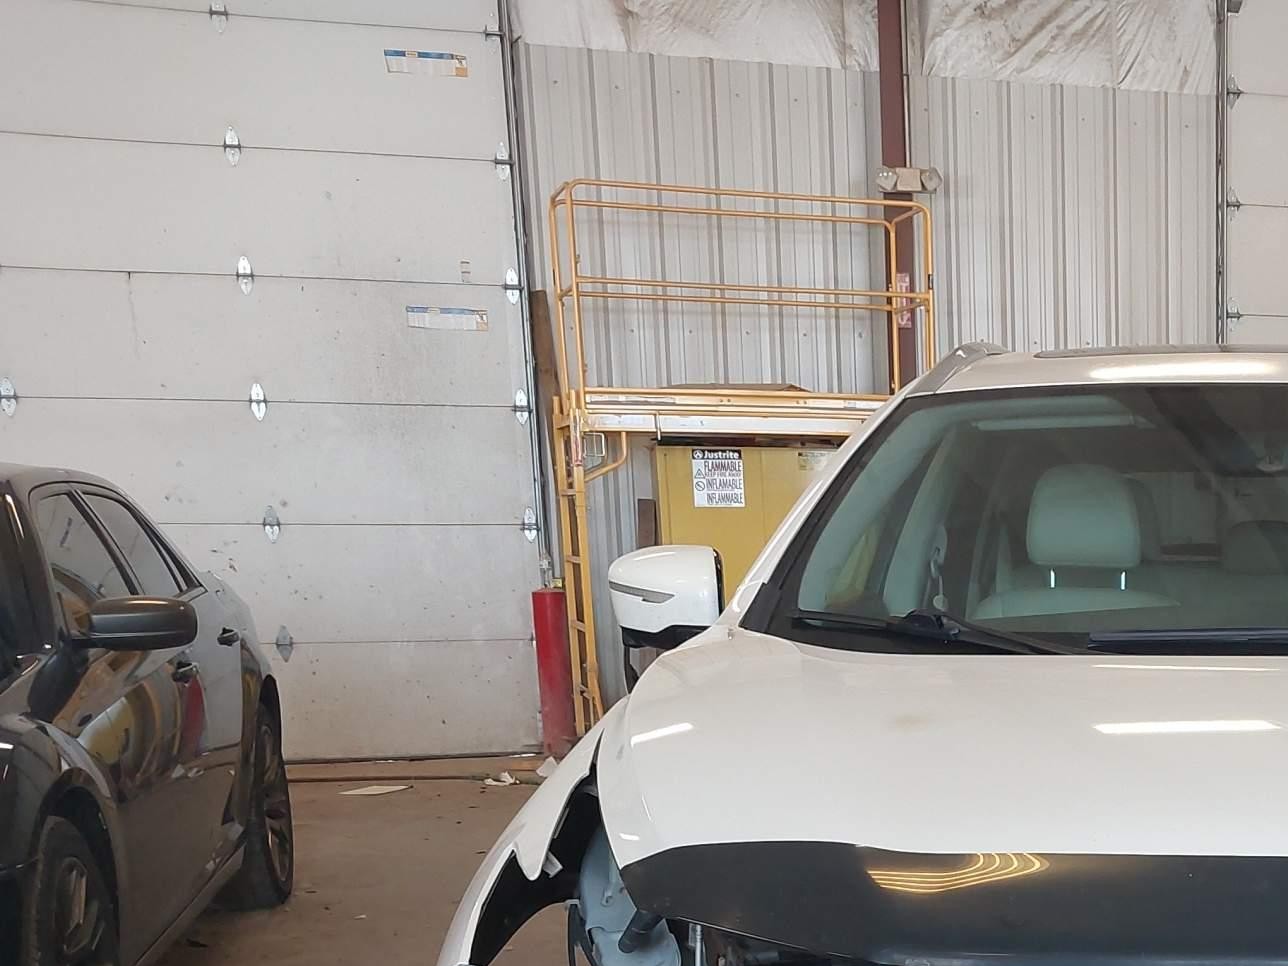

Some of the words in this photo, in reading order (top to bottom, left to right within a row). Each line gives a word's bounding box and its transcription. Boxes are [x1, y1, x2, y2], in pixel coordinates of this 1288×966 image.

[704, 450, 740, 460] Justrite
[704, 460, 742, 472] FLAMMABLE
[706, 478, 743, 490] INFLAMABLE
[707, 492, 744, 504] INFLAMMABLE
